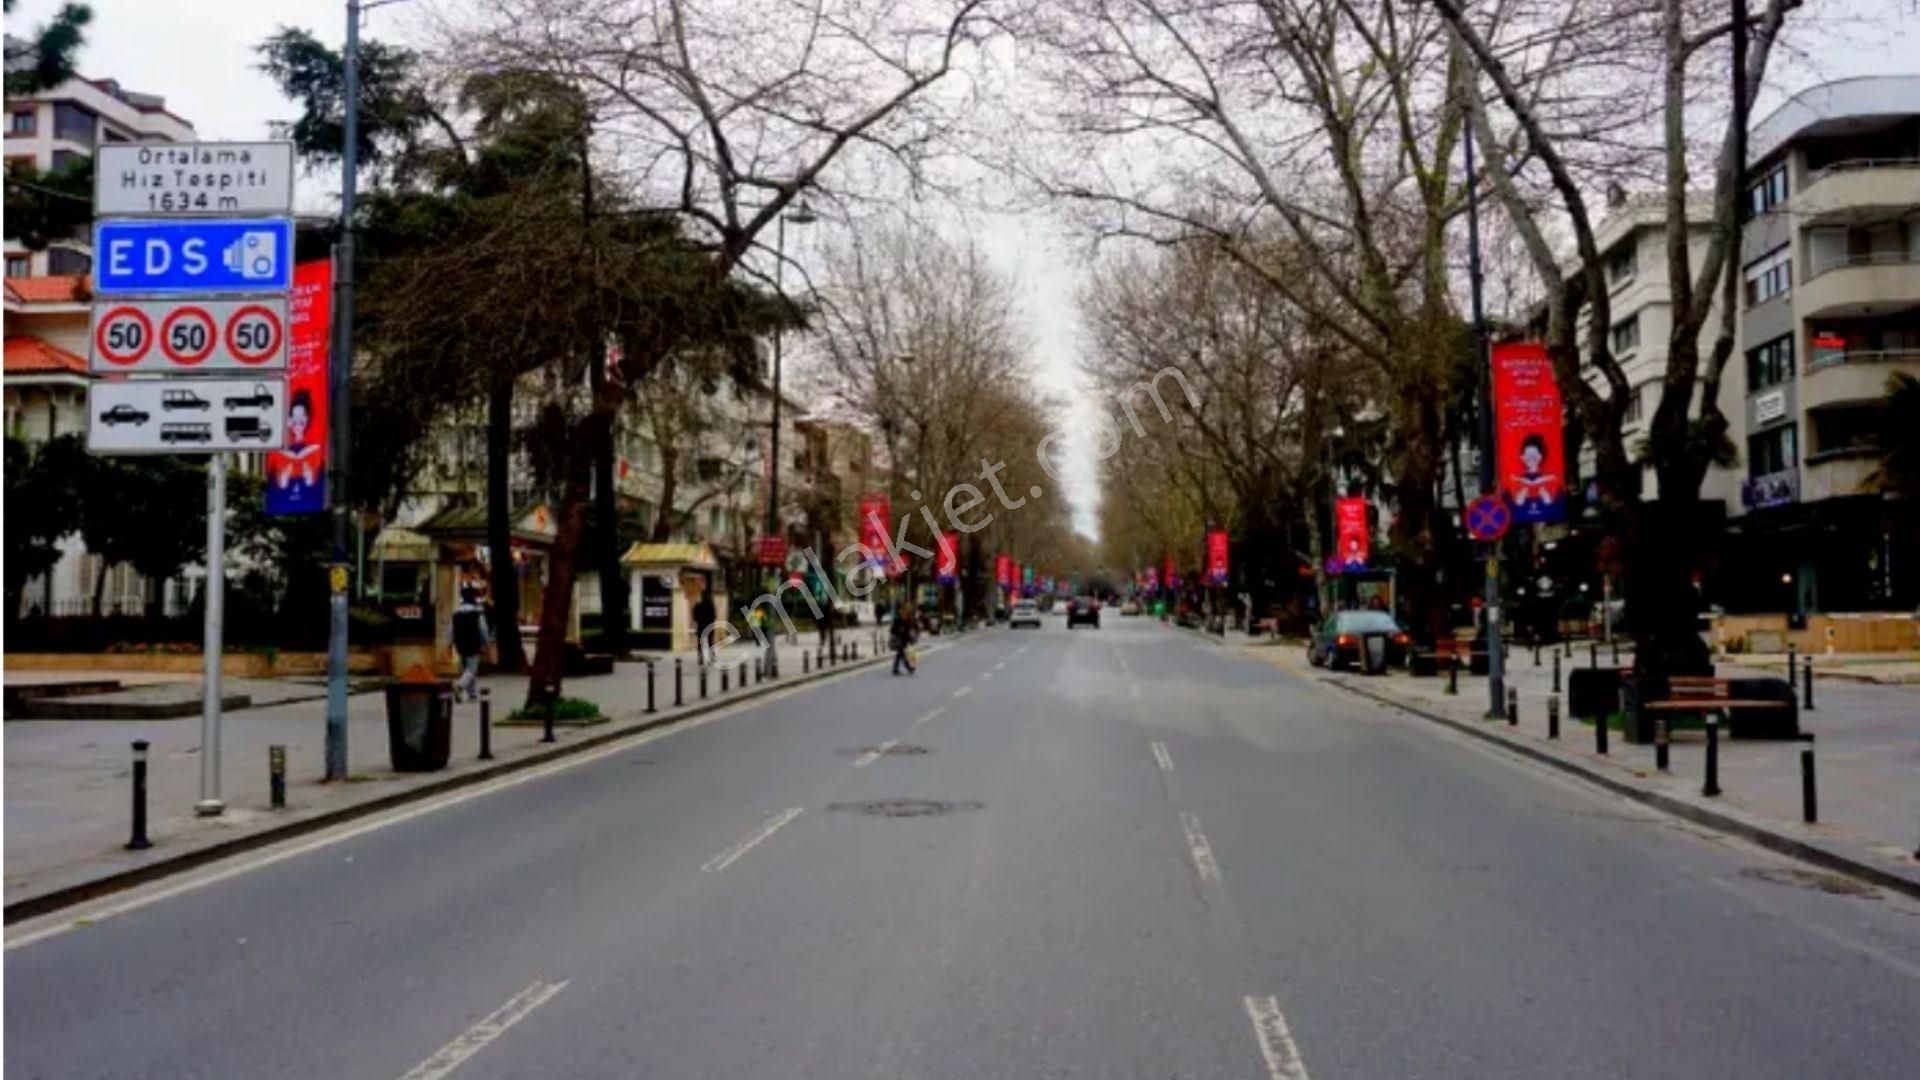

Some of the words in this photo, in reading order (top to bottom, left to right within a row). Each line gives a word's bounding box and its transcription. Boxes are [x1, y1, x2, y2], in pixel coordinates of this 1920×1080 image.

[138, 149, 252, 165] Ortalama
[174, 169, 267, 190] Tespiti
[149, 192, 208, 211] 1634
[217, 195, 239, 209] m
[109, 237, 209, 276] EDS
[108, 322, 143, 349] 50
[171, 324, 206, 351] 50
[236, 322, 271, 349] 50
